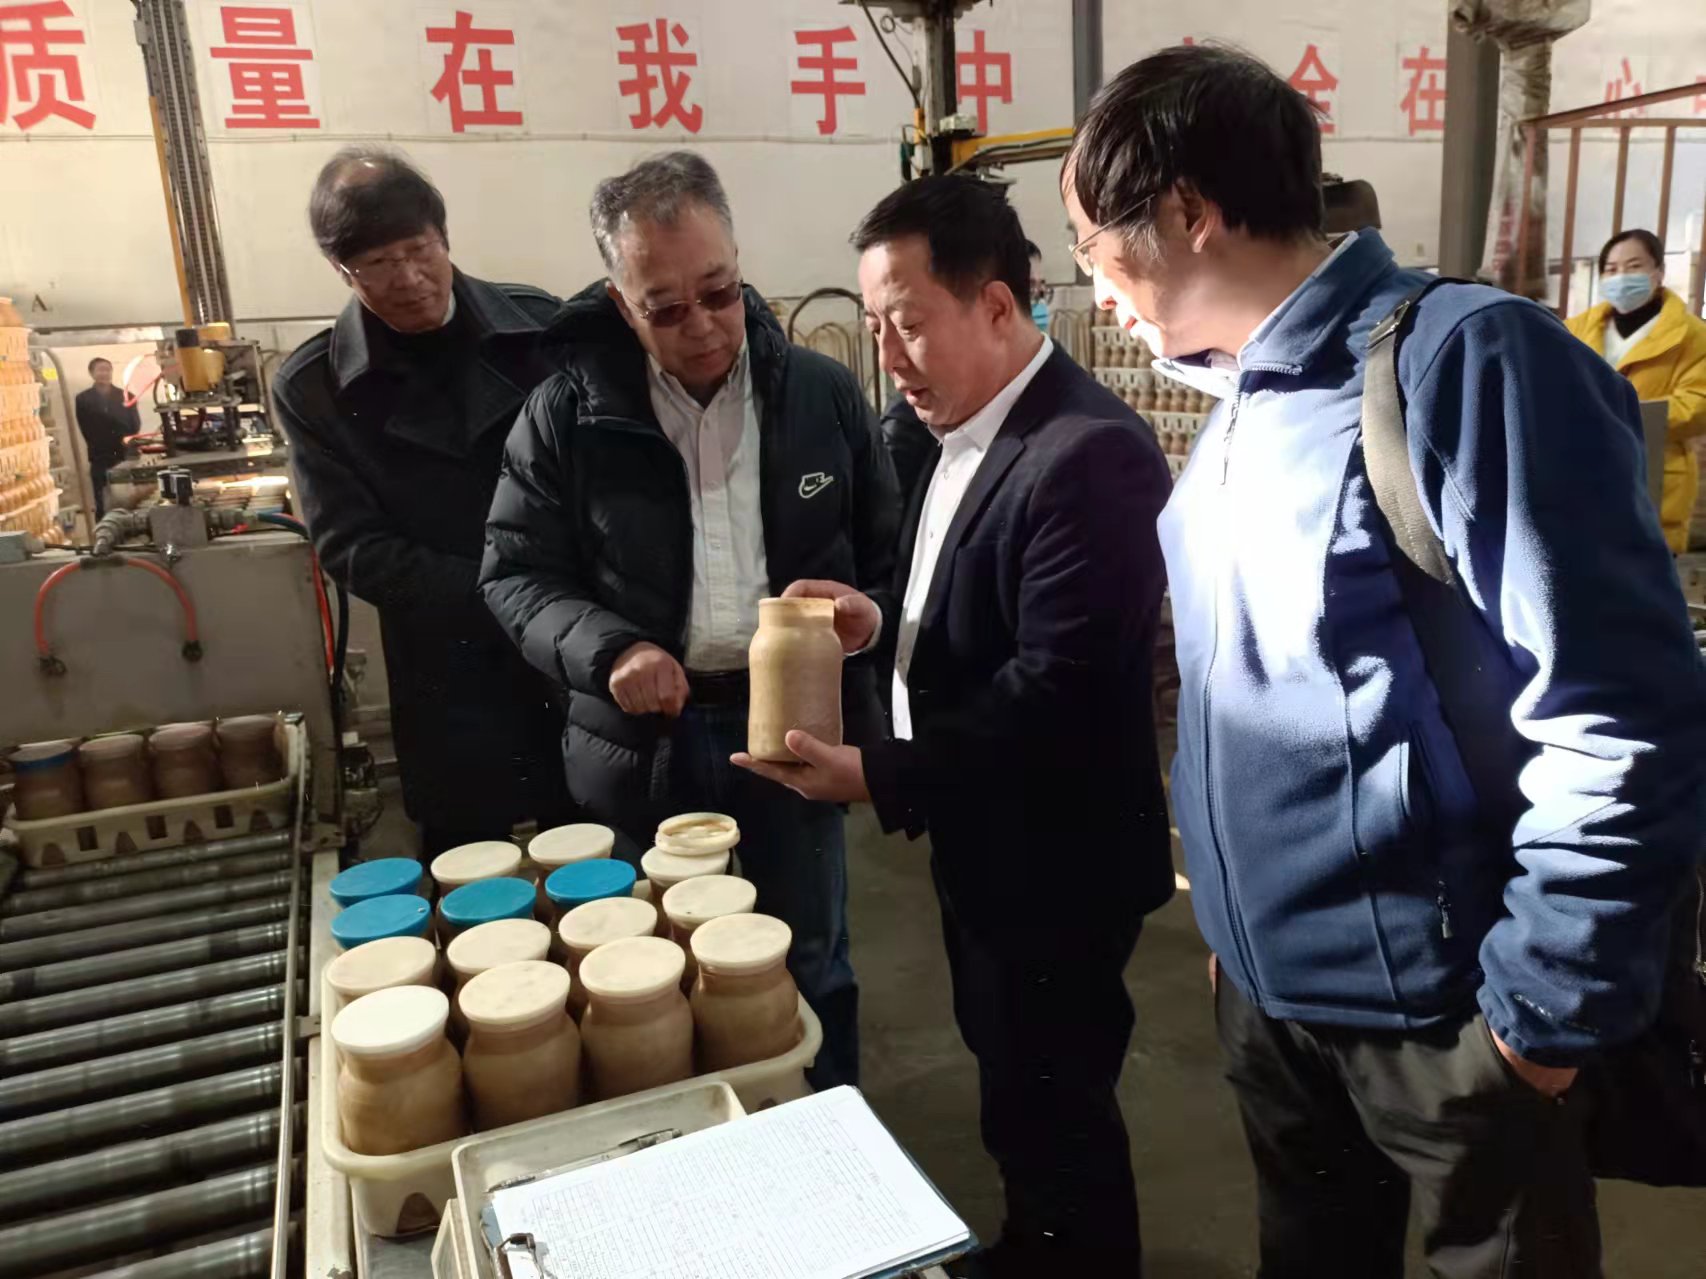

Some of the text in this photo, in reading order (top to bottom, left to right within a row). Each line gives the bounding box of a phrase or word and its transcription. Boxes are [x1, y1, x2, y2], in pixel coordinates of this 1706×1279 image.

[0, 0, 1012, 135] 质量在我手中
